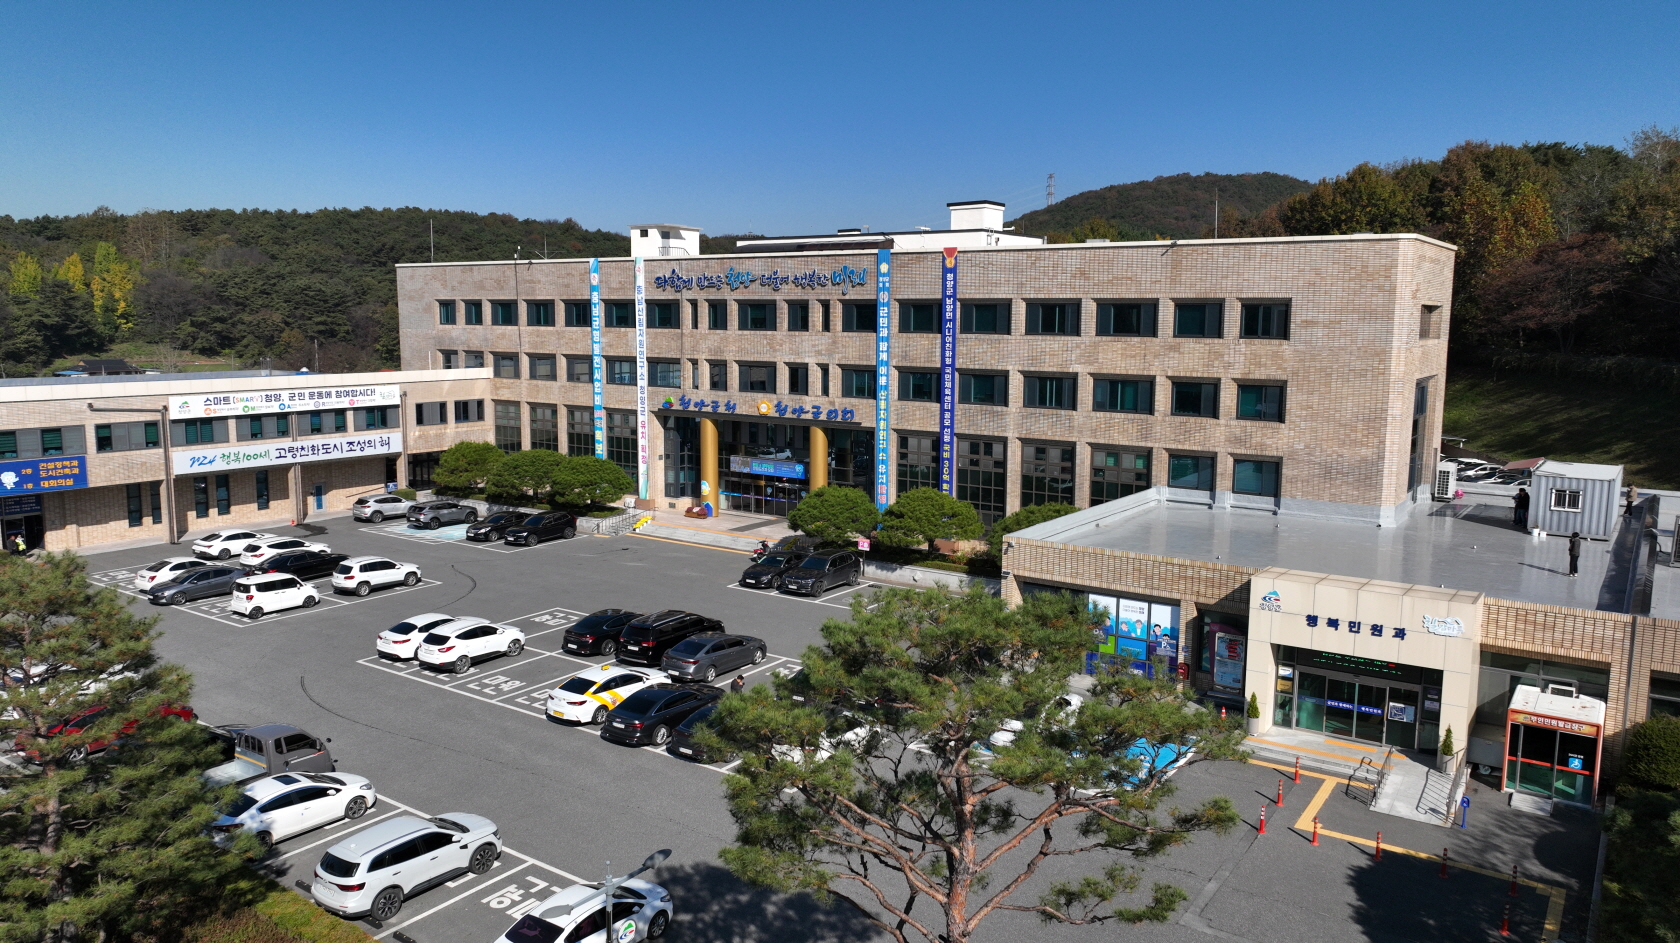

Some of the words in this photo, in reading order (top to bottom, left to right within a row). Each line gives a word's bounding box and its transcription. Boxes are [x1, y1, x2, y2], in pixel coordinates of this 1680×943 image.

[654, 268, 695, 291] 다함께
[696, 274, 724, 290] 만드는
[725, 266, 758, 289] 청양
[760, 268, 791, 290] 더불어
[792, 268, 829, 289] 행복한
[831, 265, 868, 295] 미래
[946, 273, 954, 295] 청양군
[879, 307, 888, 337] 군민과
[879, 342, 888, 361] 함께
[879, 366, 888, 386] 이룬
[204, 395, 231, 406] 스마트
[288, 392, 306, 401] 군민
[308, 390, 333, 400] 운동에
[335, 388, 376, 399] 참여합시다!
[678, 394, 737, 413] 청양군청
[774, 400, 855, 421] 청양군의회
[943, 411, 951, 426] 공모
[639, 420, 647, 440] 유치
[879, 390, 888, 459] 산림자원연구소
[943, 428, 951, 442] 선정
[275, 442, 343, 459] 고령친화도시
[346, 439, 377, 453] 조성의
[378, 436, 391, 451] 해
[640, 444, 647, 465] 확정
[943, 444, 951, 458] 국비
[39, 460, 78, 469] 건설정책과
[942, 460, 950, 481] 30억
[40, 478, 74, 488] 대회의실
[1305, 613, 1407, 640] 행복민원과
[466, 675, 526, 695] 민원
[1530, 716, 1585, 731] 무인민원발급창구
